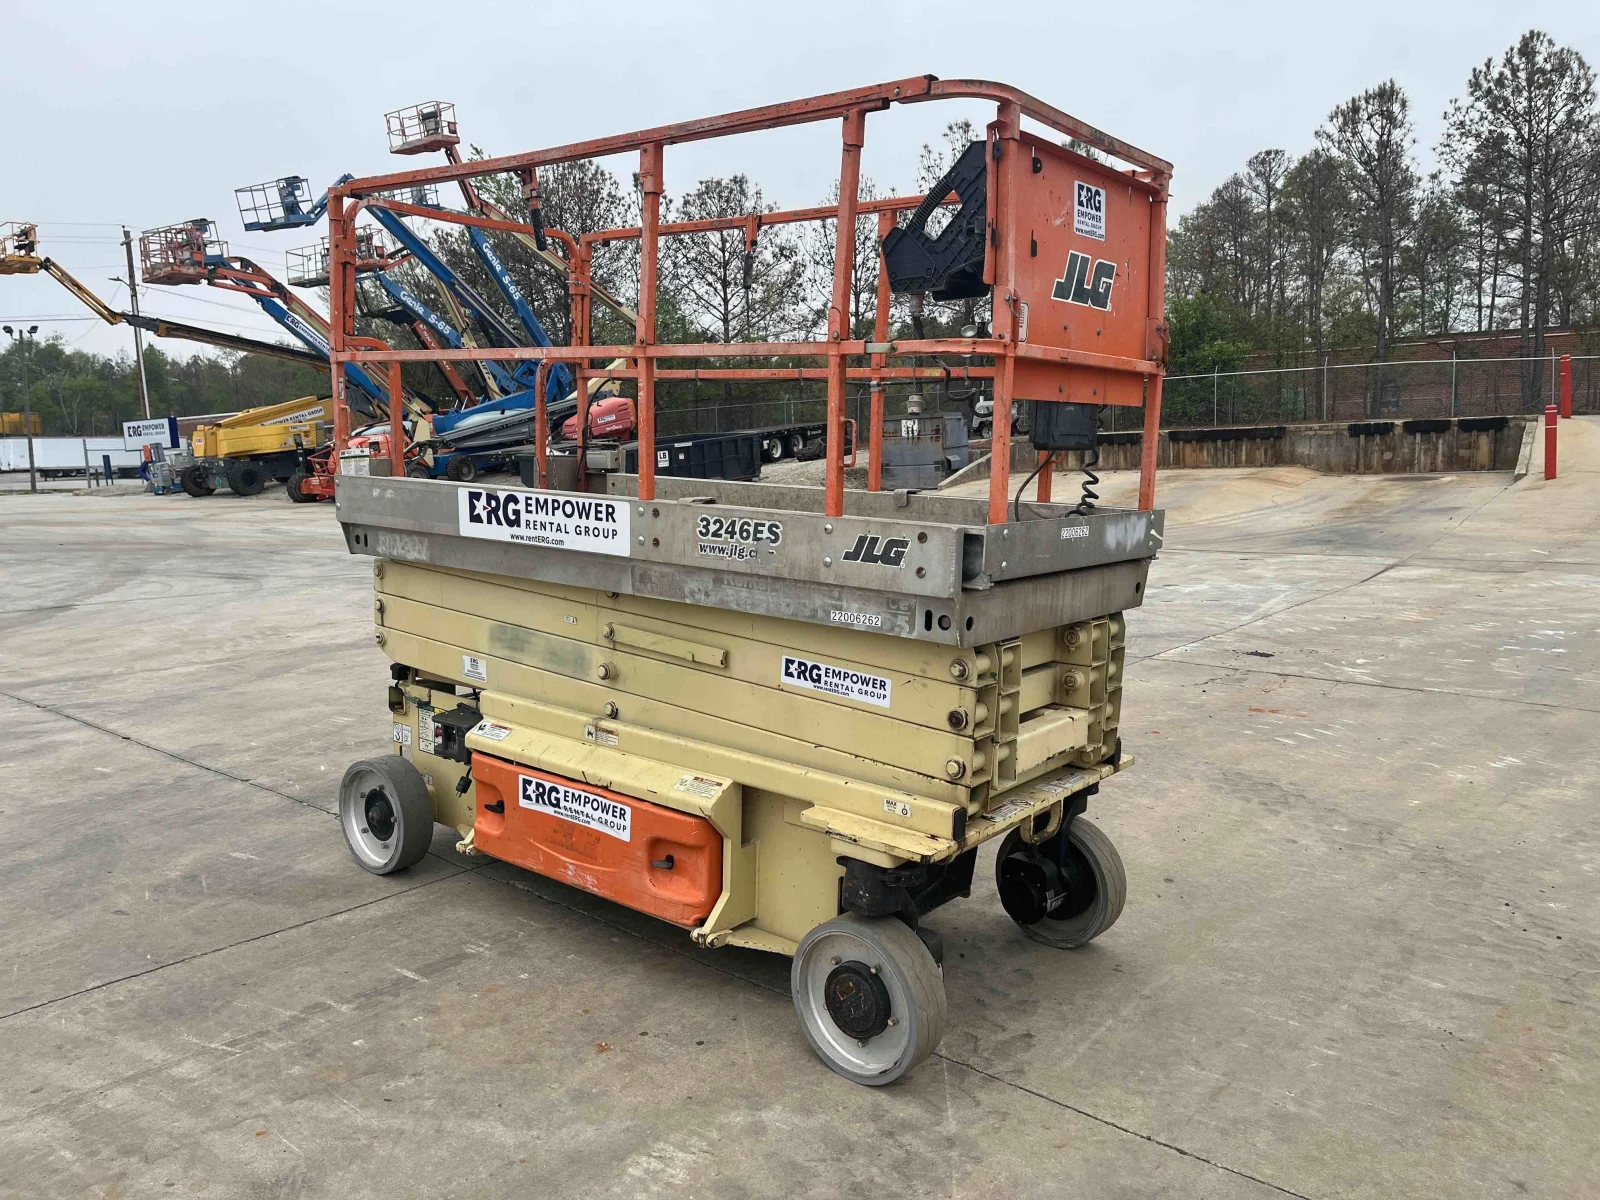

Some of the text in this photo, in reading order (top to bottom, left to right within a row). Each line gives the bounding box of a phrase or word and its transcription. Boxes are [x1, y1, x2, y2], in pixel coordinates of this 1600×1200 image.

[1077, 183, 1102, 213] ERG
[1077, 208, 1102, 224] EMPOWER
[1077, 219, 1102, 230] RENTAL GROUP
[481, 242, 522, 300] Genie S-65
[1051, 250, 1117, 311] JLG
[400, 290, 452, 335] Genie S-65
[286, 314, 300, 329] ERG
[299, 325, 318, 343] EMPOWER
[289, 413, 307, 422] RENTAL
[307, 408, 323, 416] GROUP
[127, 423, 165, 438] ERG EMPOWER
[659, 452, 667, 460] LB
[468, 490, 617, 529] ERG EMPOWER
[510, 532, 564, 547] www.rentERG.com
[525, 519, 618, 540] RENTAL GROUP
[697, 515, 783, 545] 3246ES
[841, 533, 911, 568] JLG
[831, 610, 880, 627] 22006262
[784, 657, 887, 692] ERG EMPOWER
[813, 684, 850, 697] www.rentERG.com
[824, 680, 887, 701] RENTAL GROUP
[522, 777, 627, 822] ERG EMPOWER
[553, 809, 591, 825] www.rentERG.com
[563, 805, 627, 832] RENTAL GROUP
